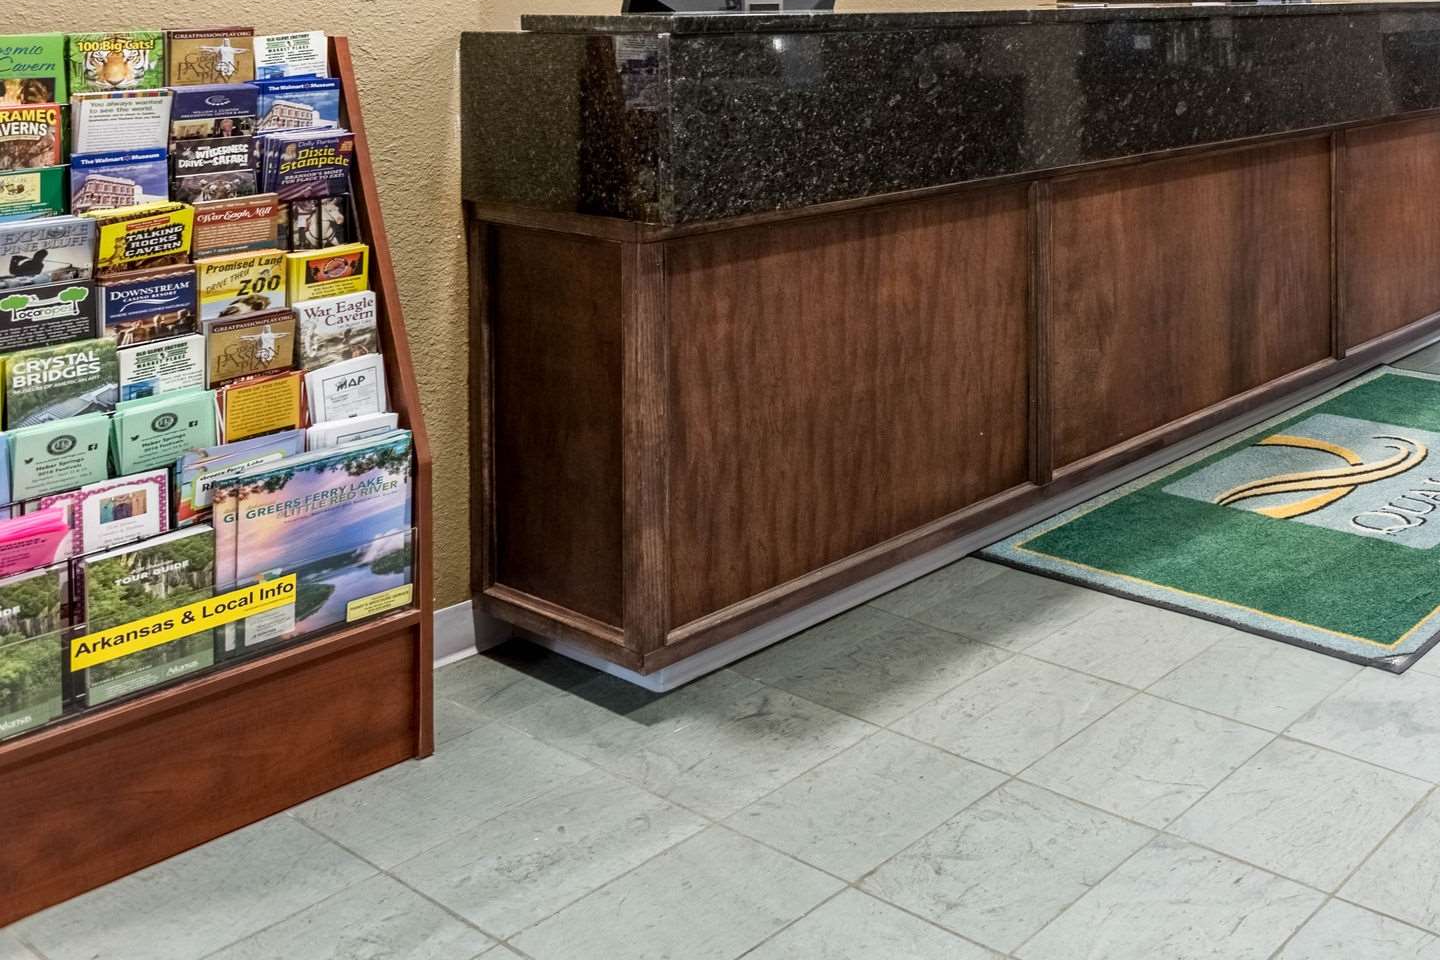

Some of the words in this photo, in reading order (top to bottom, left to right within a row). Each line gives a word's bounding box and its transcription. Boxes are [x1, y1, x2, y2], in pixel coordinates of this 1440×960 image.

[79, 41, 99, 52] 100
[102, 41, 123, 53] Big
[125, 39, 154, 50] Cats!
[95, 156, 124, 164] Walmart
[297, 145, 335, 160] Dixie
[280, 154, 350, 174] Stampede
[126, 225, 184, 242] TALKING
[130, 234, 178, 249] ROCKS
[125, 241, 181, 257] CAVERN
[206, 259, 256, 274] Promised
[257, 255, 283, 266] Land
[110, 281, 190, 301] DOWNSTREAM
[236, 274, 281, 296] ZOO
[123, 294, 149, 302] CASINO
[151, 290, 177, 298] RESORT
[304, 306, 332, 320] War
[336, 297, 374, 314] Eagle
[325, 310, 374, 327] Cavern
[12, 350, 100, 375] CRYSTAL
[12, 361, 101, 389] BRIDGES
[246, 497, 301, 520] GREERS
[304, 485, 346, 504] FERRY
[350, 475, 384, 492] LAKE
[283, 500, 326, 519] LITTLE
[330, 491, 357, 505] RED
[360, 480, 398, 498] RIVER
[114, 571, 149, 586] TOUR
[152, 559, 190, 576] GUIDE
[75, 618, 175, 658] Arkansas
[181, 610, 195, 625] &
[202, 591, 254, 618] Local
[259, 581, 295, 601] Info
